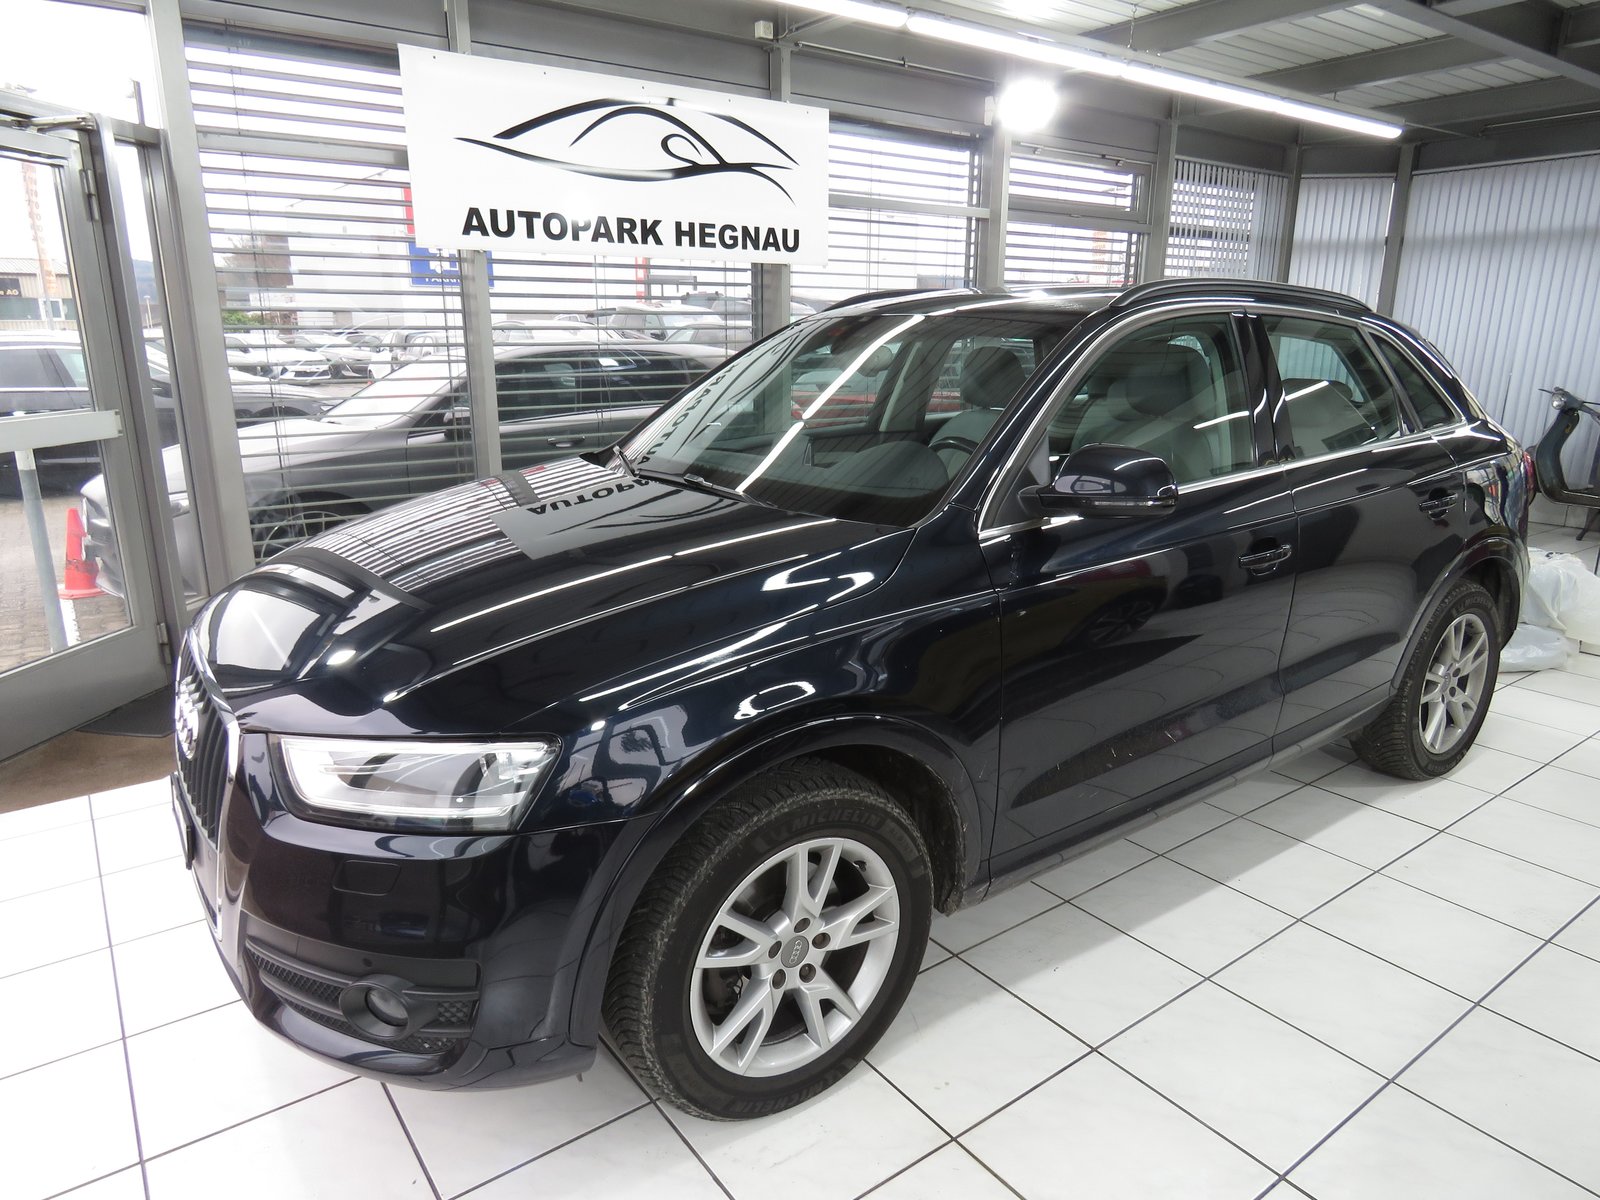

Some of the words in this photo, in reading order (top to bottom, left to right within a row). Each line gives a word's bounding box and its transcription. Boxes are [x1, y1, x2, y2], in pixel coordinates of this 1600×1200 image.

[462, 207, 663, 245] AUTOPARK
[675, 221, 800, 253] HEGNAU
[792, 808, 884, 832] MICHELIN
